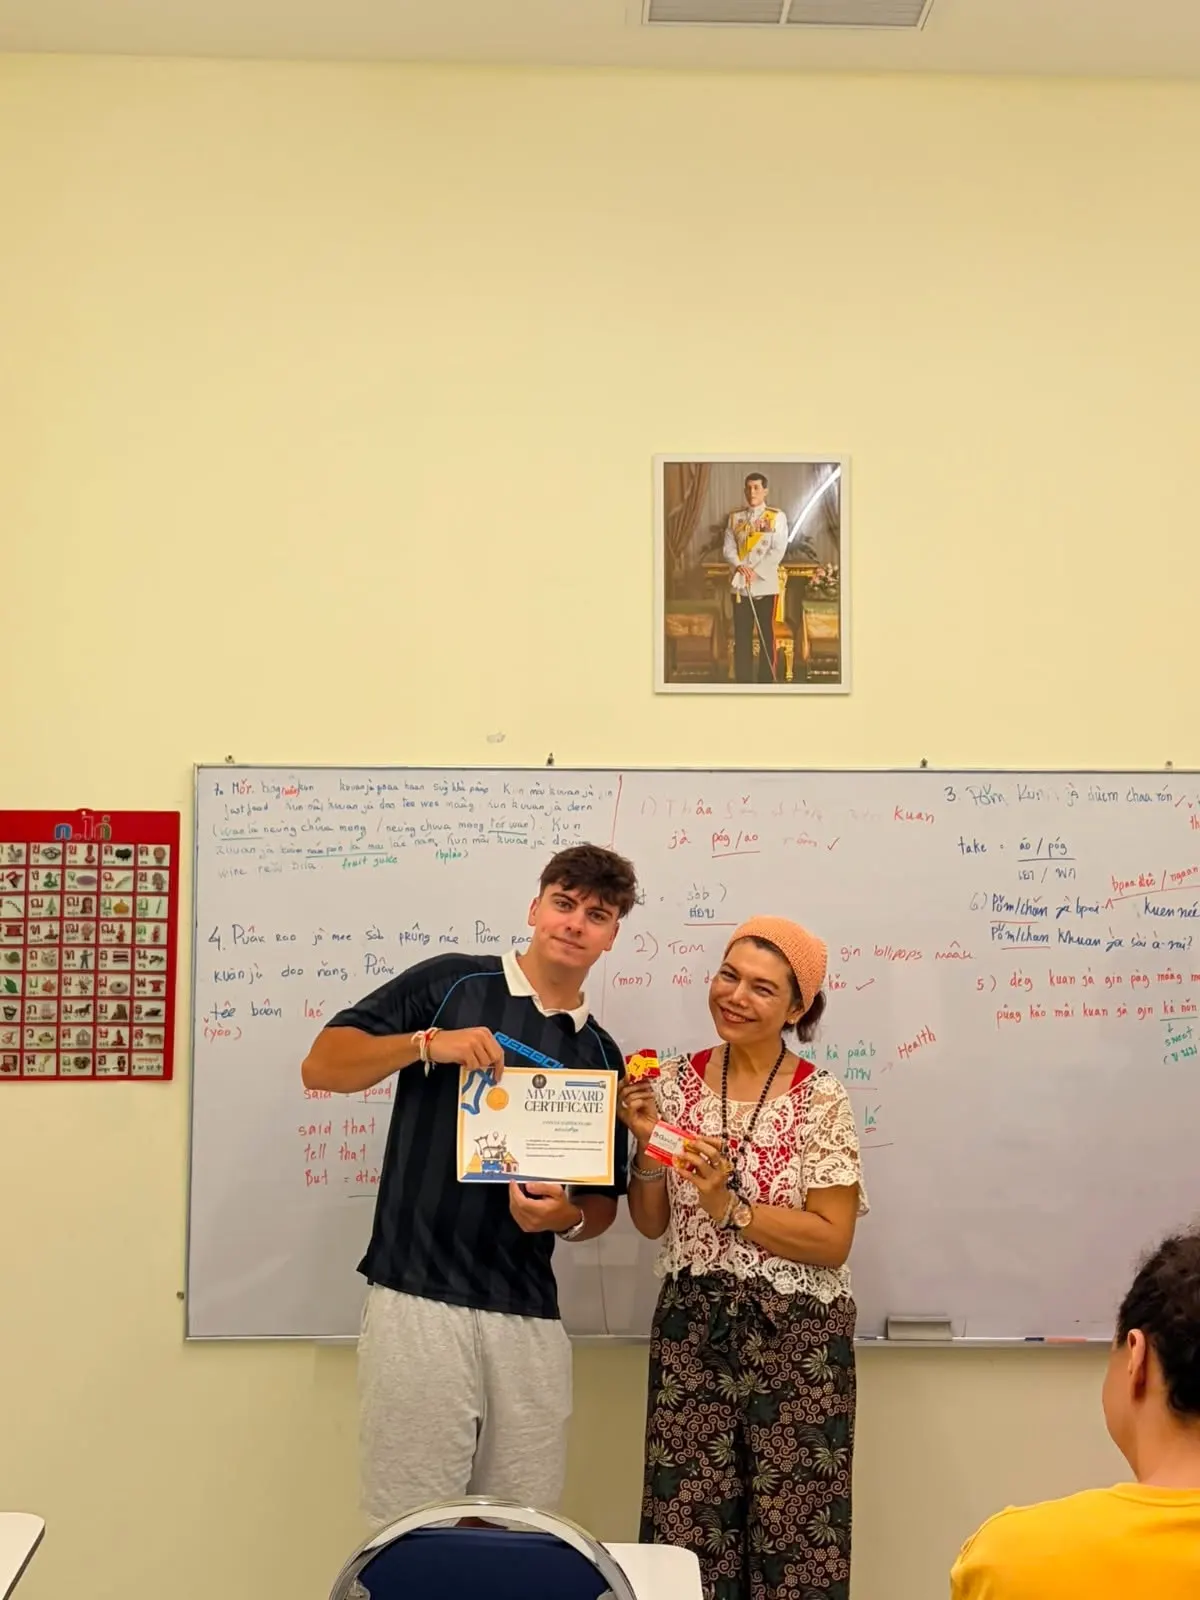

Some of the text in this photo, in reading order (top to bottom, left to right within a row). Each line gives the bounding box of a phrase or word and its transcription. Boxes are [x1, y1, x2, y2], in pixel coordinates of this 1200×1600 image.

[526, 1088, 604, 1102] MVP AWARD
[524, 1100, 604, 1114] CERTIFICATE
[298, 1117, 376, 1138] said that
[304, 1142, 367, 1163] tell that
[305, 1168, 328, 1187] But
